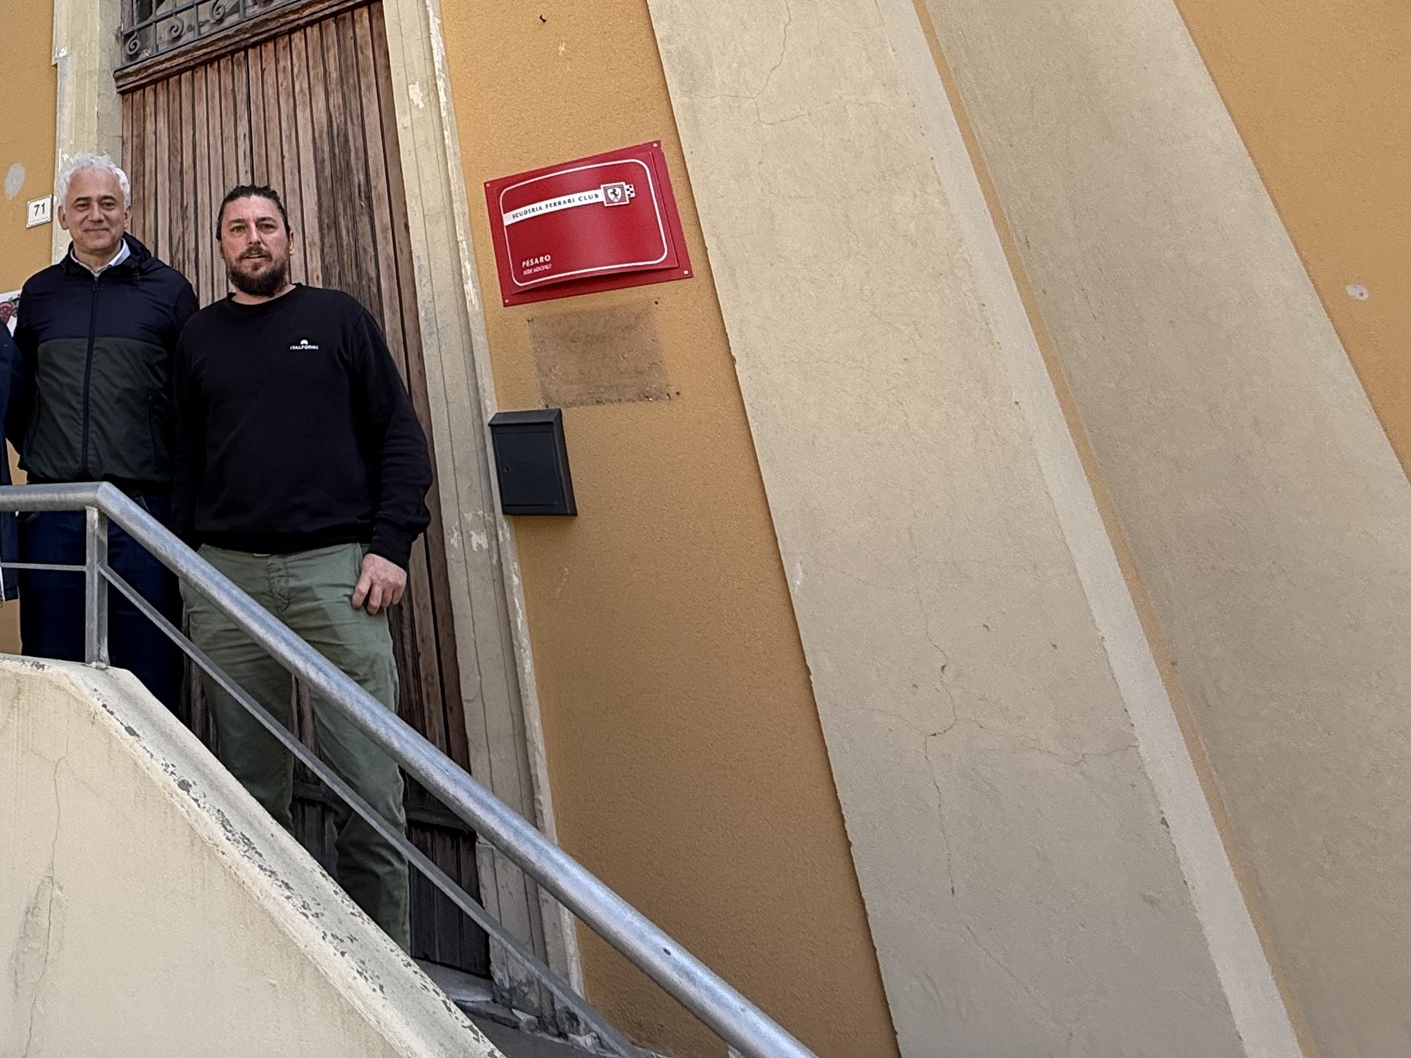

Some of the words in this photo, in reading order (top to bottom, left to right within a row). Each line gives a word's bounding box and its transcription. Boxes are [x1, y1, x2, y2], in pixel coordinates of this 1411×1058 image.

[34, 202, 45, 216] 71
[512, 205, 543, 219] SCUDERIA
[545, 198, 575, 209] FERRARI
[578, 193, 599, 202] CLUB
[522, 254, 551, 268] PESARO
